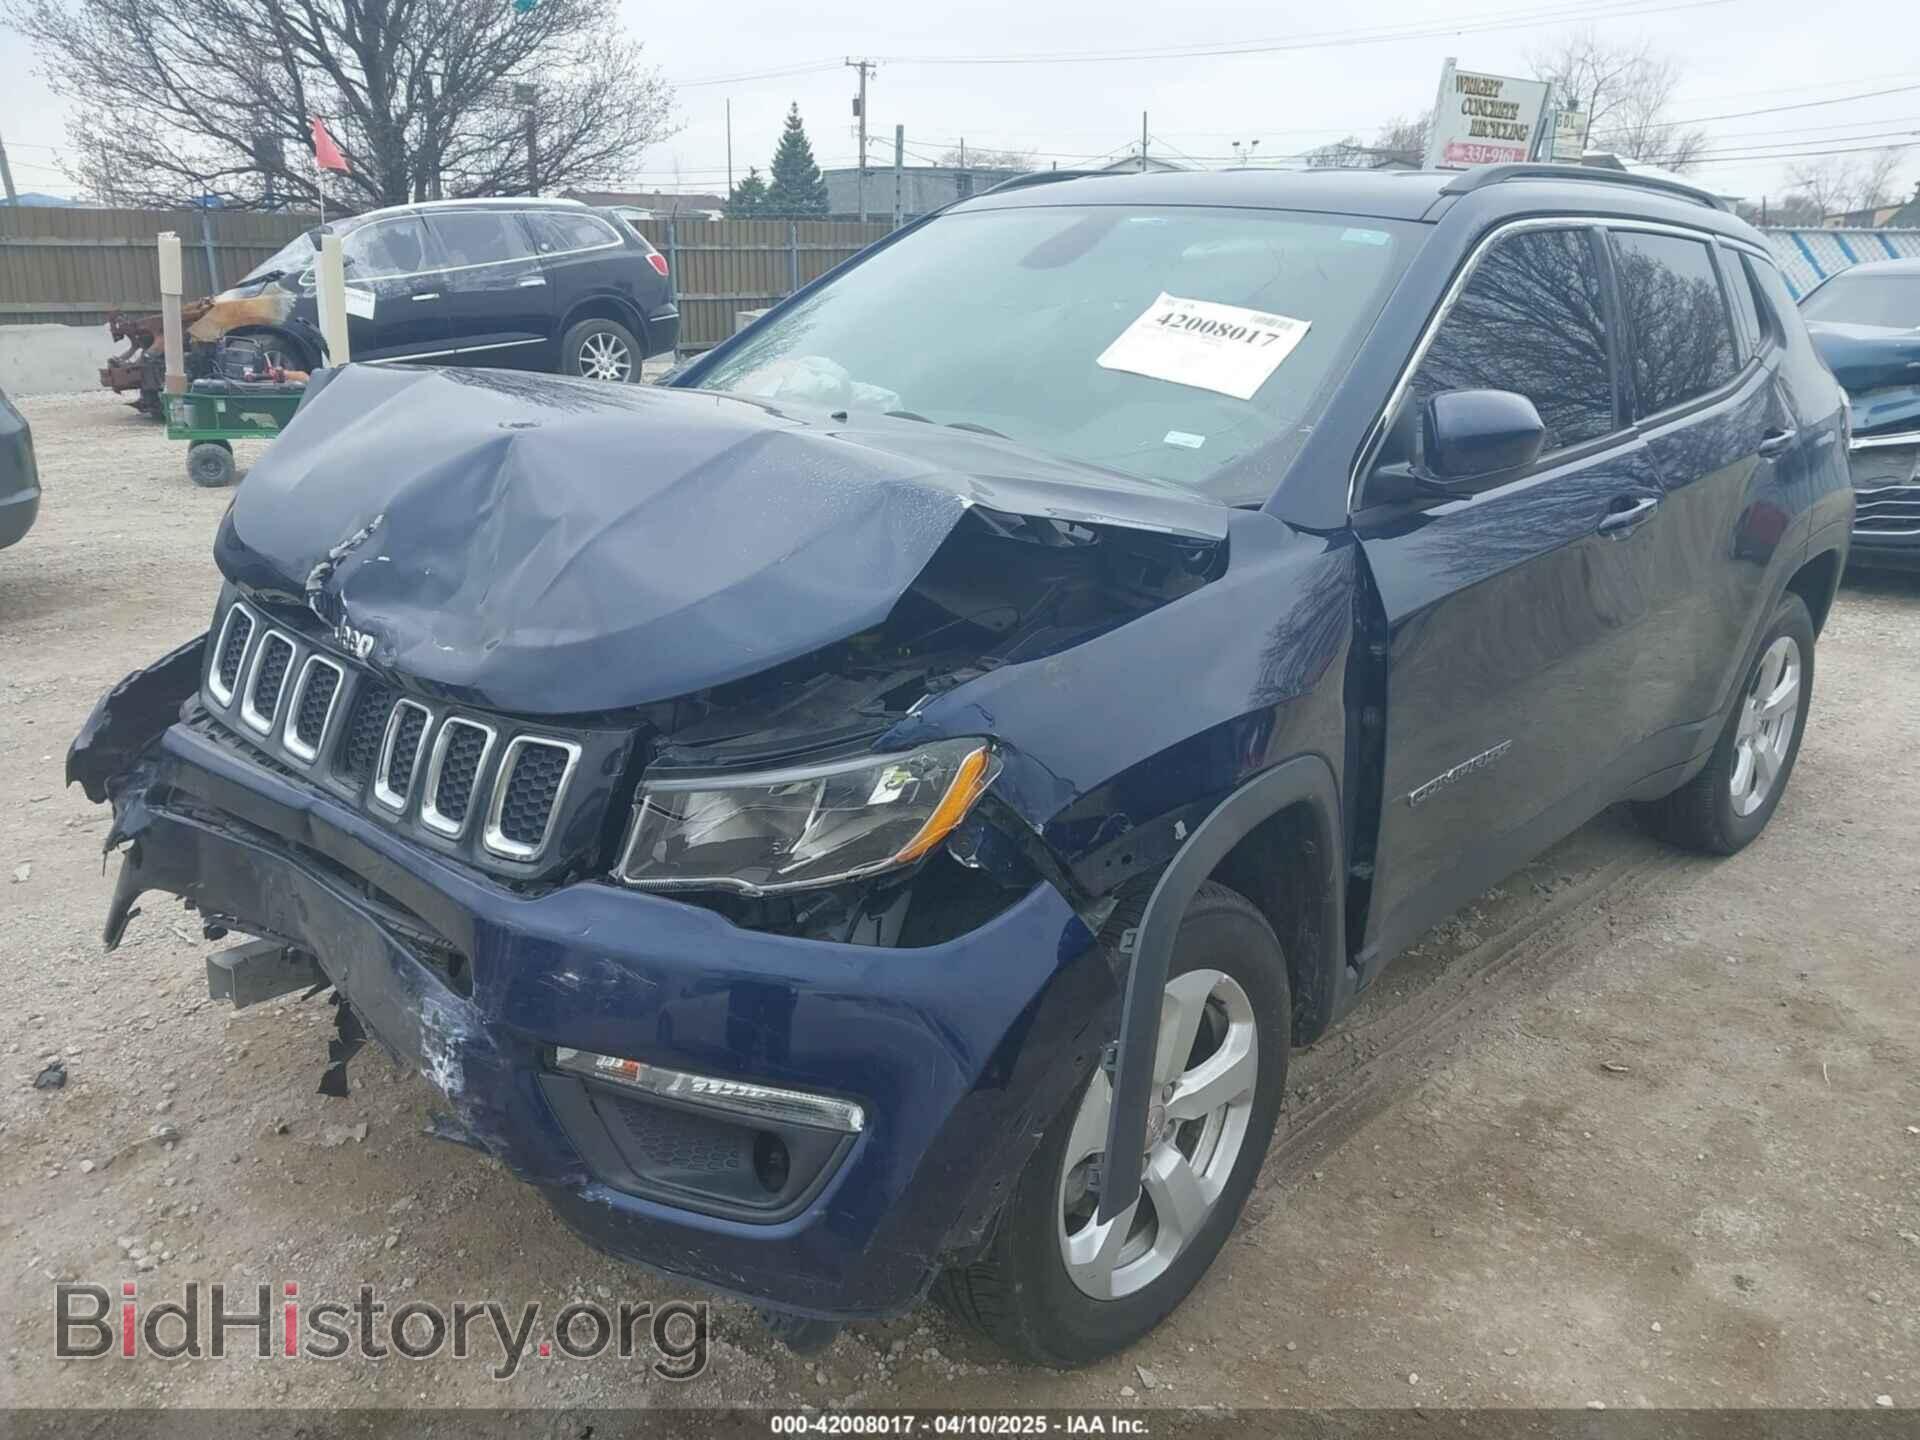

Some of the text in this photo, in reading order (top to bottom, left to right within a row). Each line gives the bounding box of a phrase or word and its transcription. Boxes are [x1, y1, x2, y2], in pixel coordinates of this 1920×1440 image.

[1455, 74, 1504, 98] WRIGHT
[1461, 97, 1520, 120] CONCRETE
[1468, 118, 1529, 142] RECYCLING
[1156, 311, 1280, 347] 42008017
